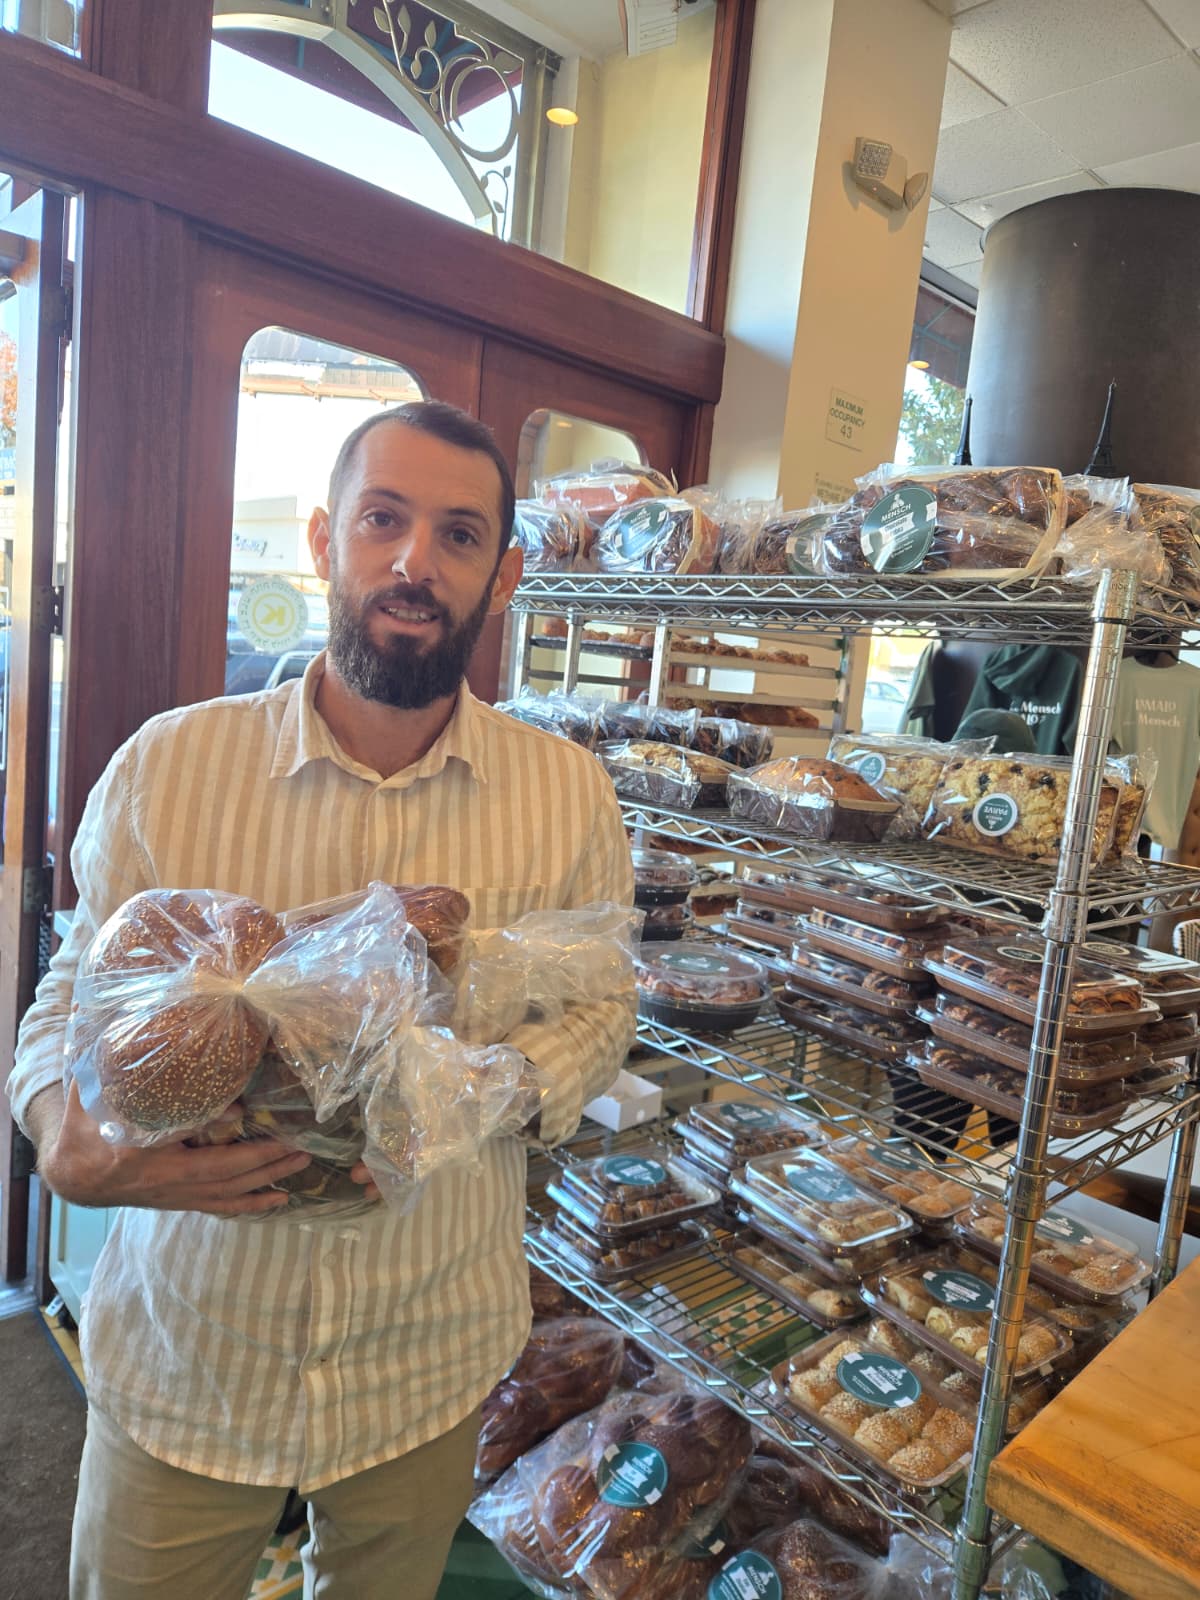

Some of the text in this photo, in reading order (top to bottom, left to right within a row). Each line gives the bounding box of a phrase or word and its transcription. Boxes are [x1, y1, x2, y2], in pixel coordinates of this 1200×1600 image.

[835, 397, 864, 416] MAXIMUM
[830, 407, 865, 428] OCCUPANCY
[840, 424, 852, 440] 43
[881, 503, 911, 521] MENSCH
[1138, 712, 1181, 728] Mensch
[983, 804, 1009, 816] PARVE
